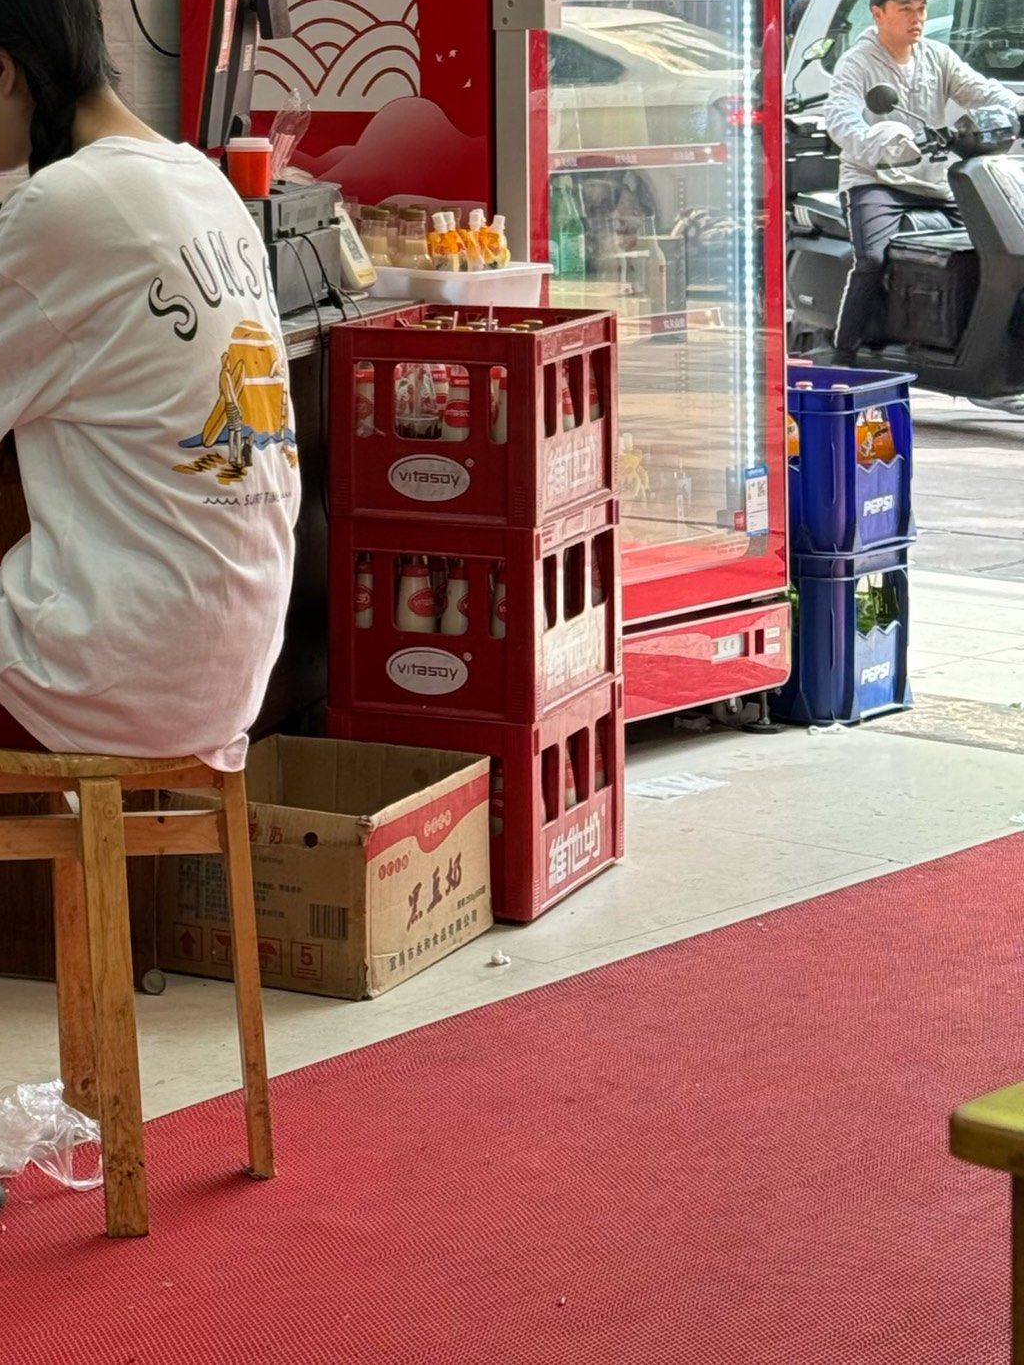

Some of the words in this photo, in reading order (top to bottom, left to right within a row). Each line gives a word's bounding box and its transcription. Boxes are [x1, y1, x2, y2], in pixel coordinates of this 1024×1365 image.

[399, 470, 460, 487] vitasoy
[863, 493, 894, 518] PEPSI
[397, 663, 459, 682] vitasoy
[861, 661, 890, 685] PEPSI
[548, 811, 601, 889] 维他奶
